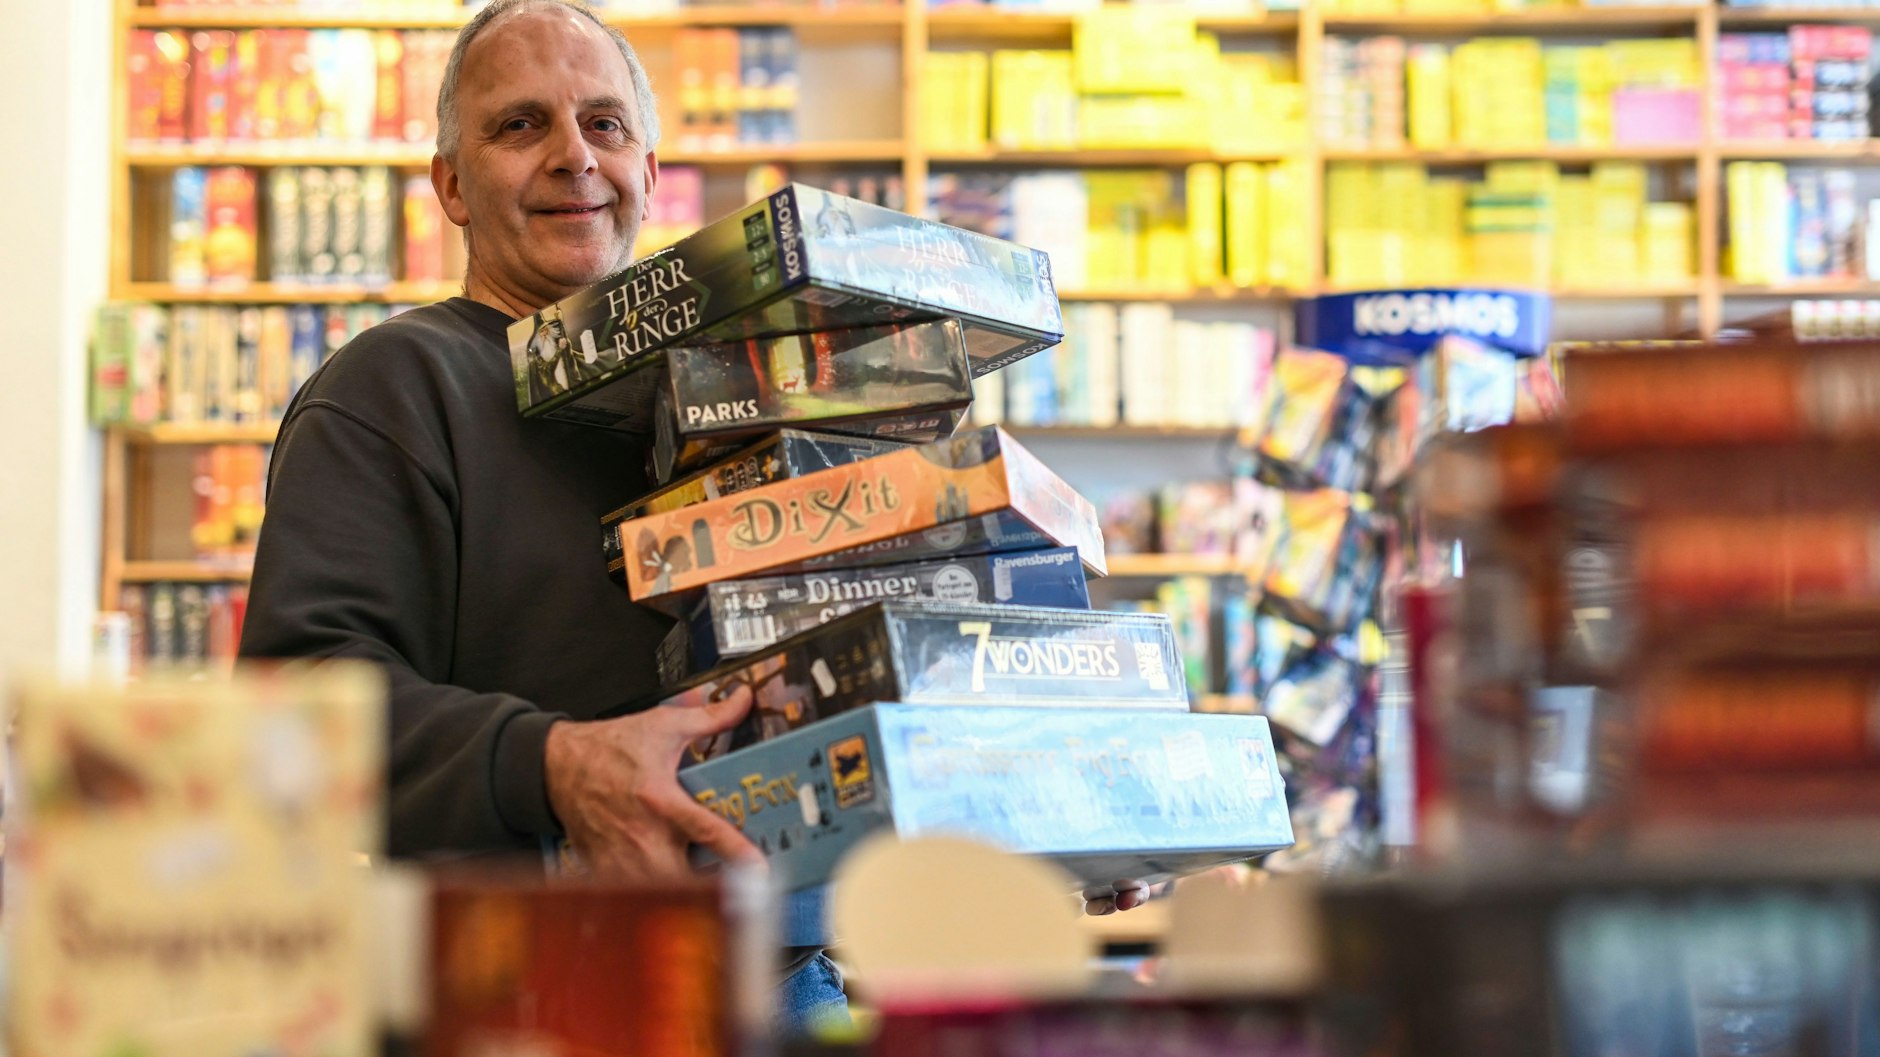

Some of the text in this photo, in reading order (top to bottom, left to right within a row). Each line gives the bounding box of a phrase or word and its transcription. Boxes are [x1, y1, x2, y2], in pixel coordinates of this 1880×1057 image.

[776, 193, 801, 280] KOSMOS
[605, 257, 693, 326] HERR
[613, 297, 701, 362] RINGE
[1353, 293, 1519, 337] KOSMOS
[977, 343, 1049, 374] KOSMOS
[686, 399, 760, 425] PARKS
[993, 551, 1075, 568] Ravensburger
[805, 575, 918, 605] Dinner
[958, 621, 992, 693] 7
[987, 638, 1121, 677] WONDERS
